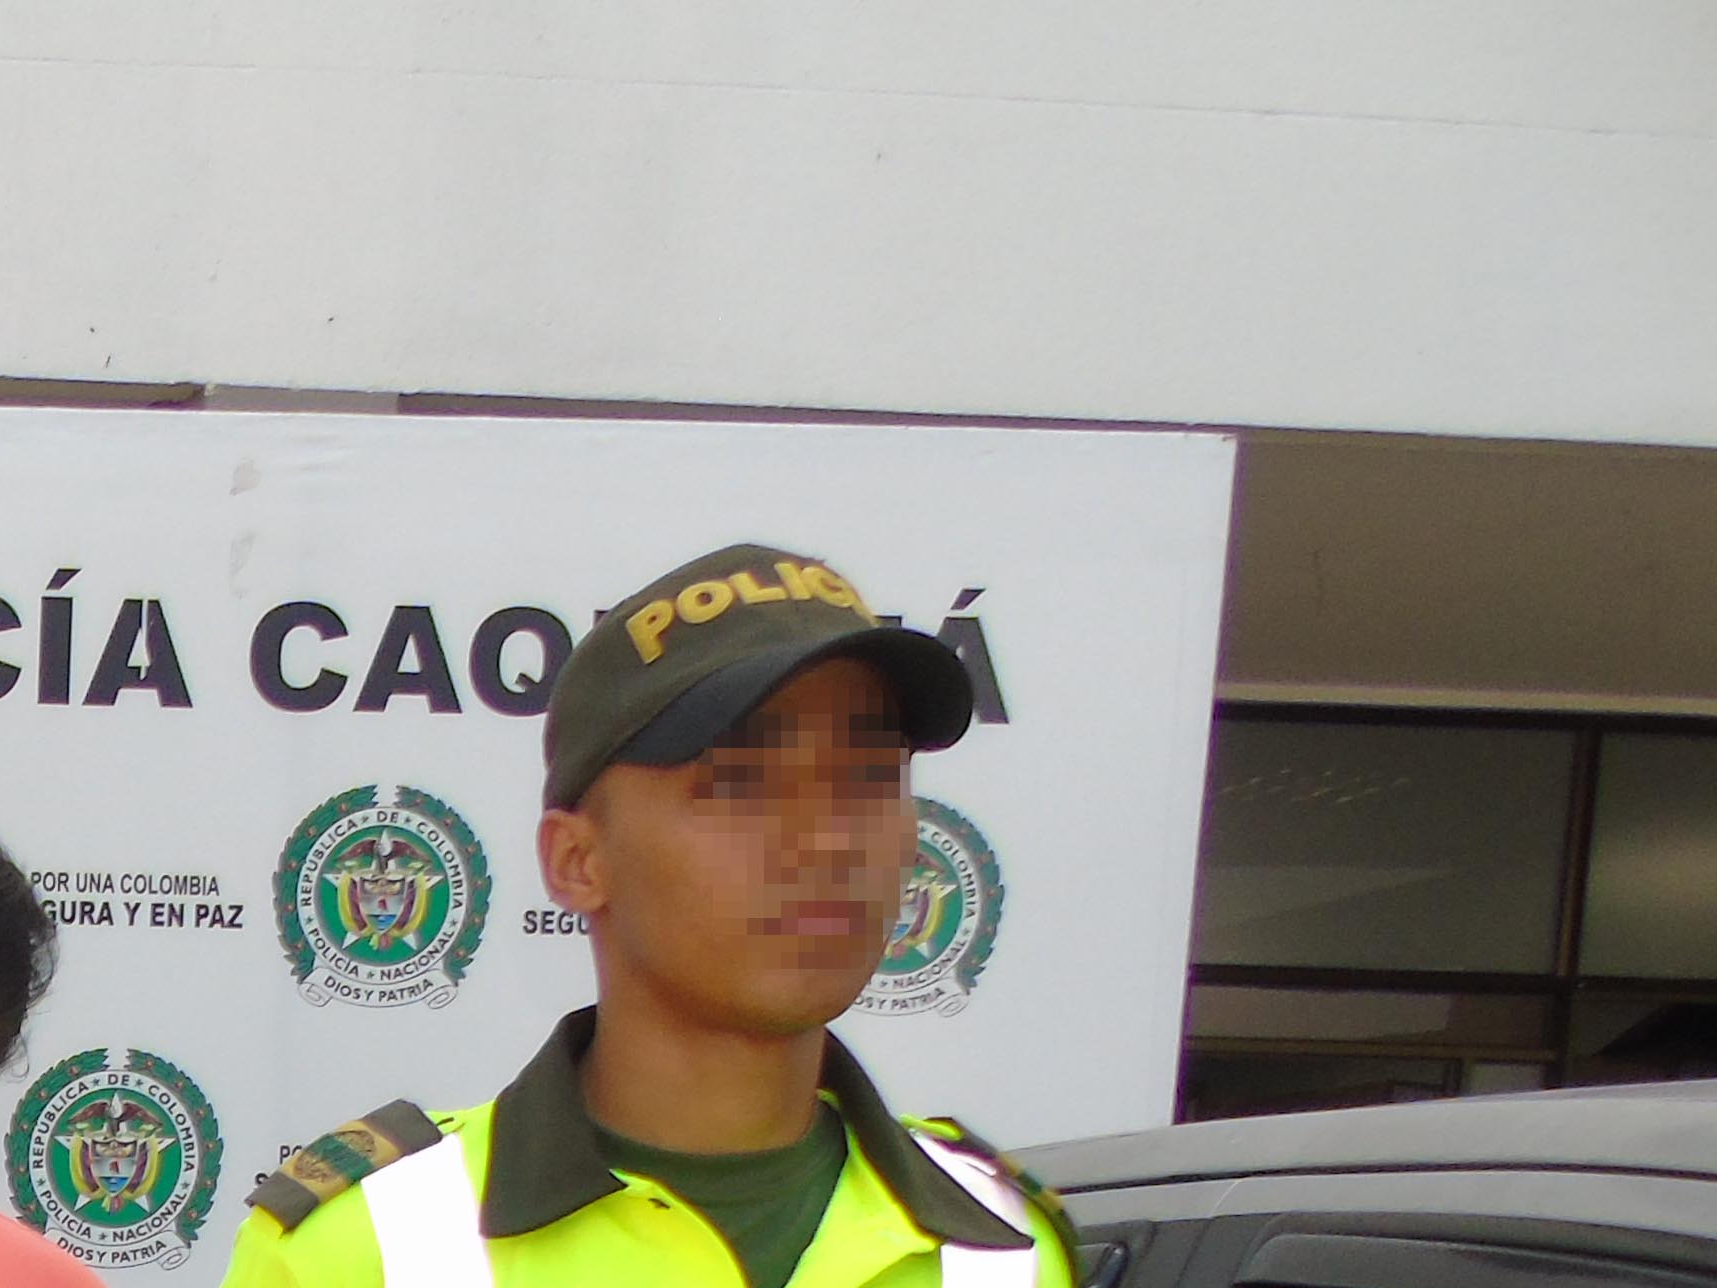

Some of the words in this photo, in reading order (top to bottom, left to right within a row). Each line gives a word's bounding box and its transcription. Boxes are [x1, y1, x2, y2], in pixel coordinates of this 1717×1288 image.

[249, 588, 1011, 725] CAQÁ
[376, 810, 399, 823] DE
[417, 821, 464, 910] COLOMBIA
[31, 871, 69, 893] POR
[76, 873, 115, 894] UNA
[120, 873, 220, 896] COLOMBIA
[41, 900, 114, 926] GURA
[123, 902, 142, 926] Y
[150, 903, 185, 928] EN
[195, 904, 244, 929] PAZ
[523, 909, 591, 935] SEGU
[379, 930, 455, 982] NACIONAL
[324, 975, 362, 999] DIOS
[364, 990, 374, 1002] Y
[378, 979, 434, 1002] PATRIA
[108, 1073, 130, 1086] DE
[148, 1084, 195, 1172] COLOMBIA
[112, 1192, 188, 1242] NACIONAL
[56, 1236, 94, 1261] DIOS
[96, 1251, 107, 1264] Y
[111, 1239, 167, 1264] PATRIA
